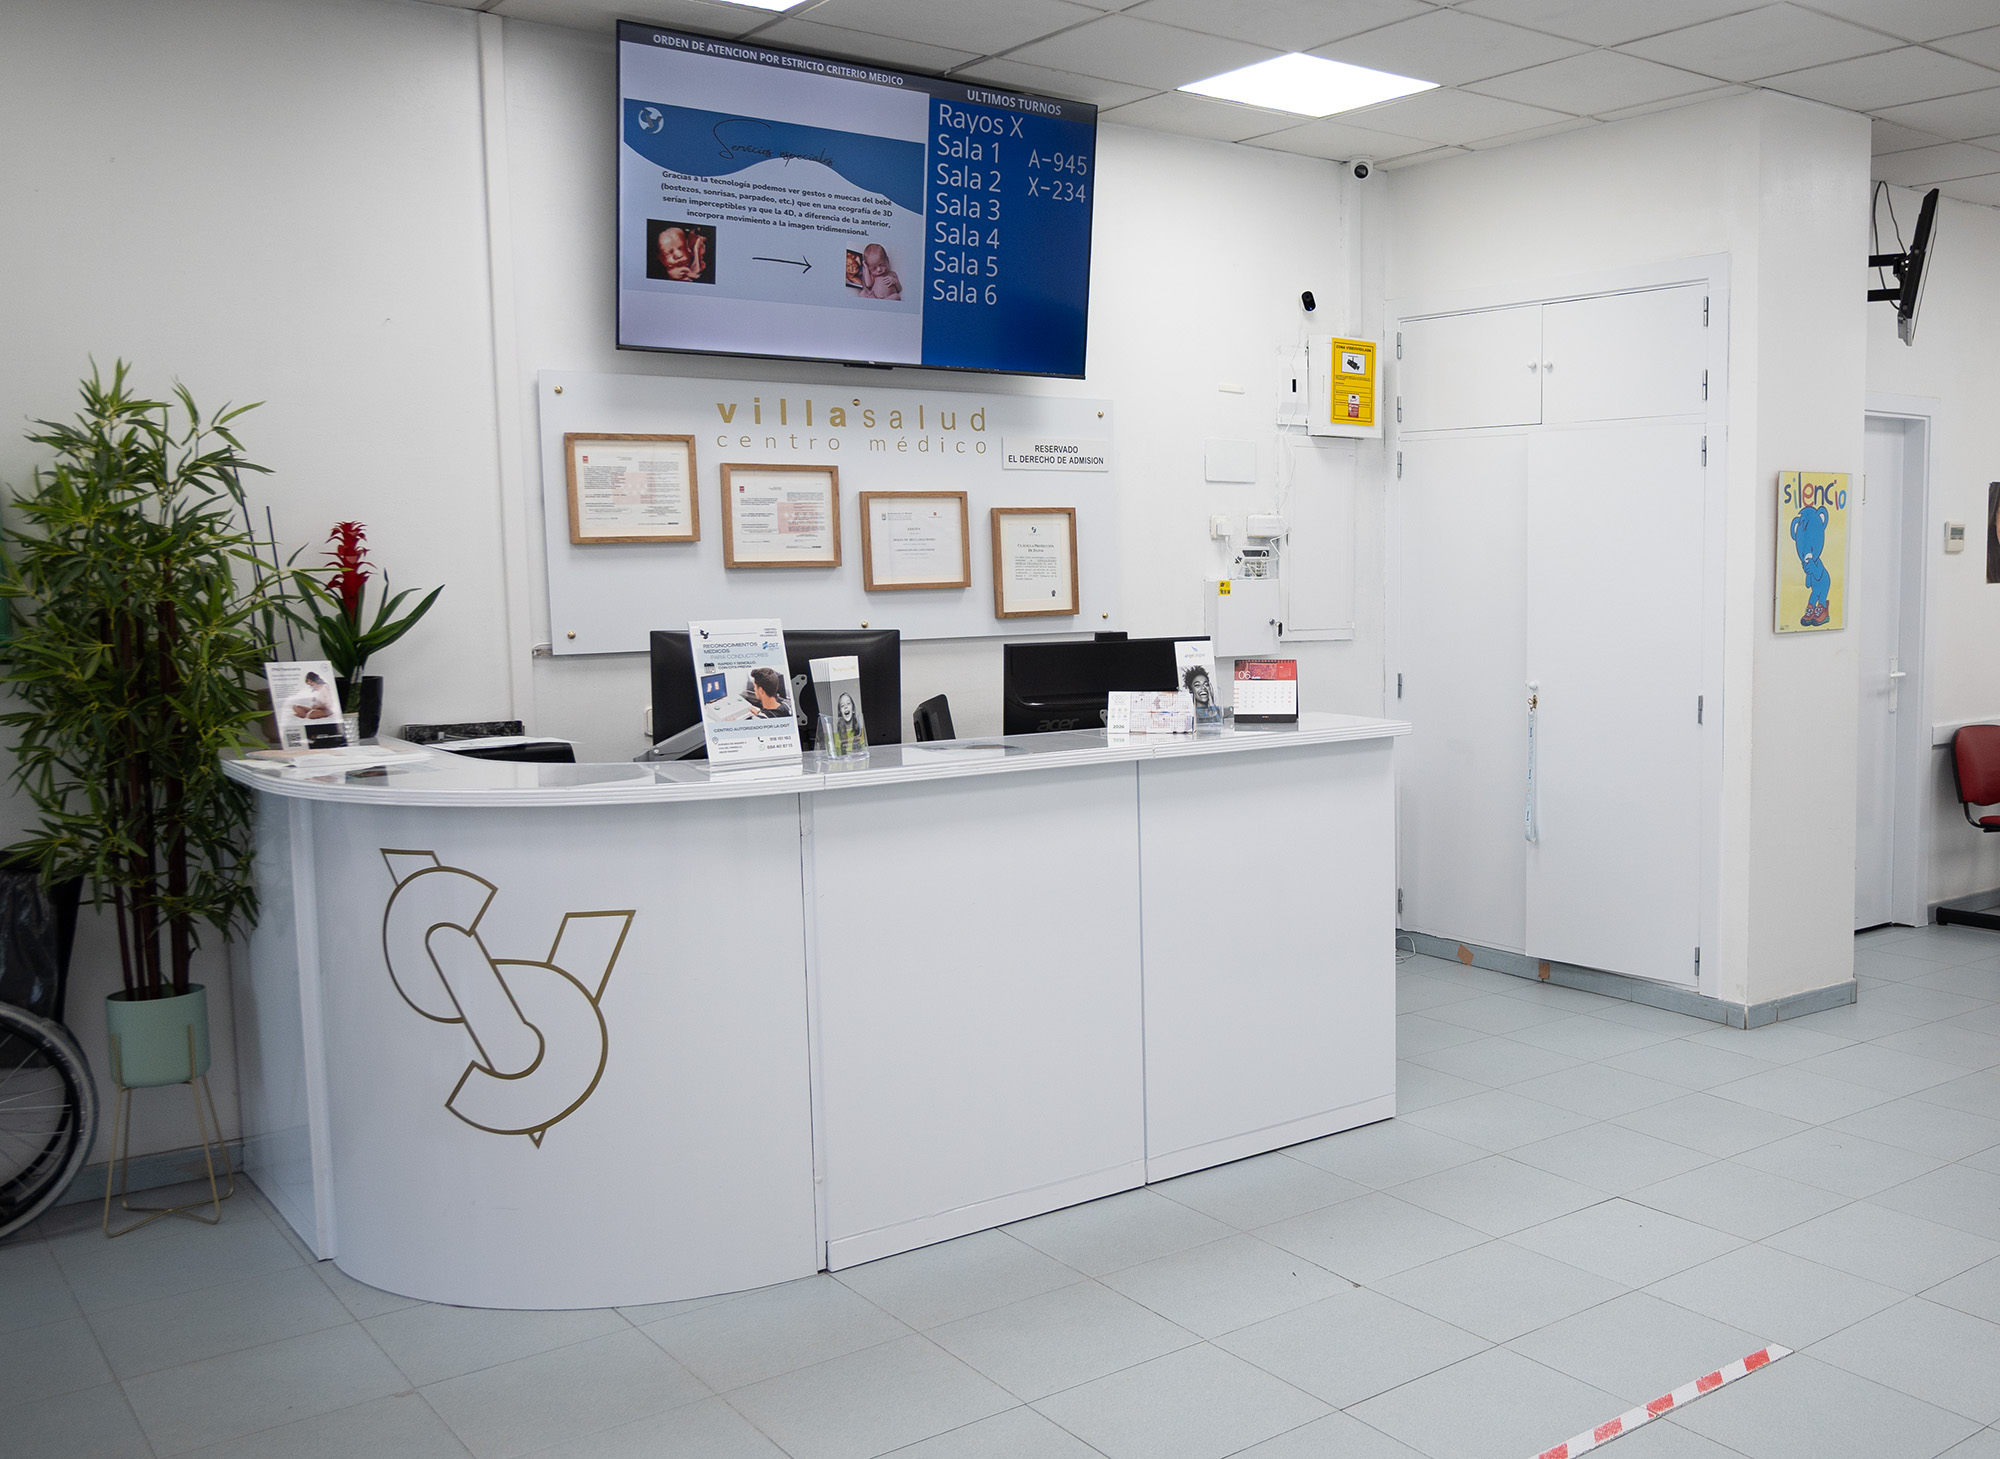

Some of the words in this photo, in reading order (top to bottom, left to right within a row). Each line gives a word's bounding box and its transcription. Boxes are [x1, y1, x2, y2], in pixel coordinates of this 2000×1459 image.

[653, 34, 689, 48] ORDEN
[692, 41, 705, 51] DE
[707, 44, 757, 60] ATENCION
[760, 53, 780, 64] POR
[782, 57, 824, 72] ESTRICTO
[827, 65, 866, 79] CRITERIO
[869, 72, 903, 85] MEDICO
[967, 89, 1016, 108] ULTIMOS
[1018, 99, 1062, 115] TURNOS
[939, 103, 1004, 135] Rayos
[1009, 116, 1023, 139] X
[713, 118, 773, 159] Servicios
[779, 147, 833, 167] especiales
[937, 134, 982, 161] Sala
[991, 142, 999, 163] 1
[1028, 149, 1087, 176] A-945
[662, 171, 692, 181] Gracias
[710, 177, 750, 189] tecnología
[753, 183, 786, 193] podemos
[802, 190, 826, 198] gestos
[834, 194, 860, 202] muecas
[936, 163, 981, 190] Sala
[989, 170, 1001, 193] 2
[1028, 176, 1086, 203] X-234
[661, 182, 701, 194] (bostezos,
[703, 189, 737, 199] sonrisas,
[739, 193, 777, 204] parpadeo,
[779, 198, 795, 206] etc.)
[872, 207, 881, 216] de
[689, 198, 746, 211] imperceptibles
[759, 207, 772, 215] que
[784, 209, 796, 218] 4D,
[804, 213, 840, 222] diferencia
[841, 215, 851, 223] de
[861, 220, 891, 228] anterior,
[936, 192, 980, 218] Sala
[987, 199, 1000, 221] 3
[687, 209, 724, 220] incorpora
[726, 215, 770, 225] movimiento
[788, 221, 815, 231] imagen
[816, 224, 869, 236] tridimensional.
[935, 222, 979, 247] Sala
[986, 228, 1000, 249] 4
[933, 251, 978, 276] Sala
[986, 256, 998, 277] 5
[933, 279, 977, 304] Sala
[985, 284, 997, 306] 6
[716, 433, 841, 451] centro
[869, 435, 987, 454] médico
[1035, 445, 1078, 454] RESERVADO
[1008, 455, 1017, 463] EL
[1020, 455, 1055, 464] DERECHO
[1057, 456, 1067, 464] DE
[1069, 456, 1104, 465] ADMISION
[1784, 472, 1846, 510] silencio
[1238, 670, 1250, 679] 06
[1037, 718, 1079, 731] acer
